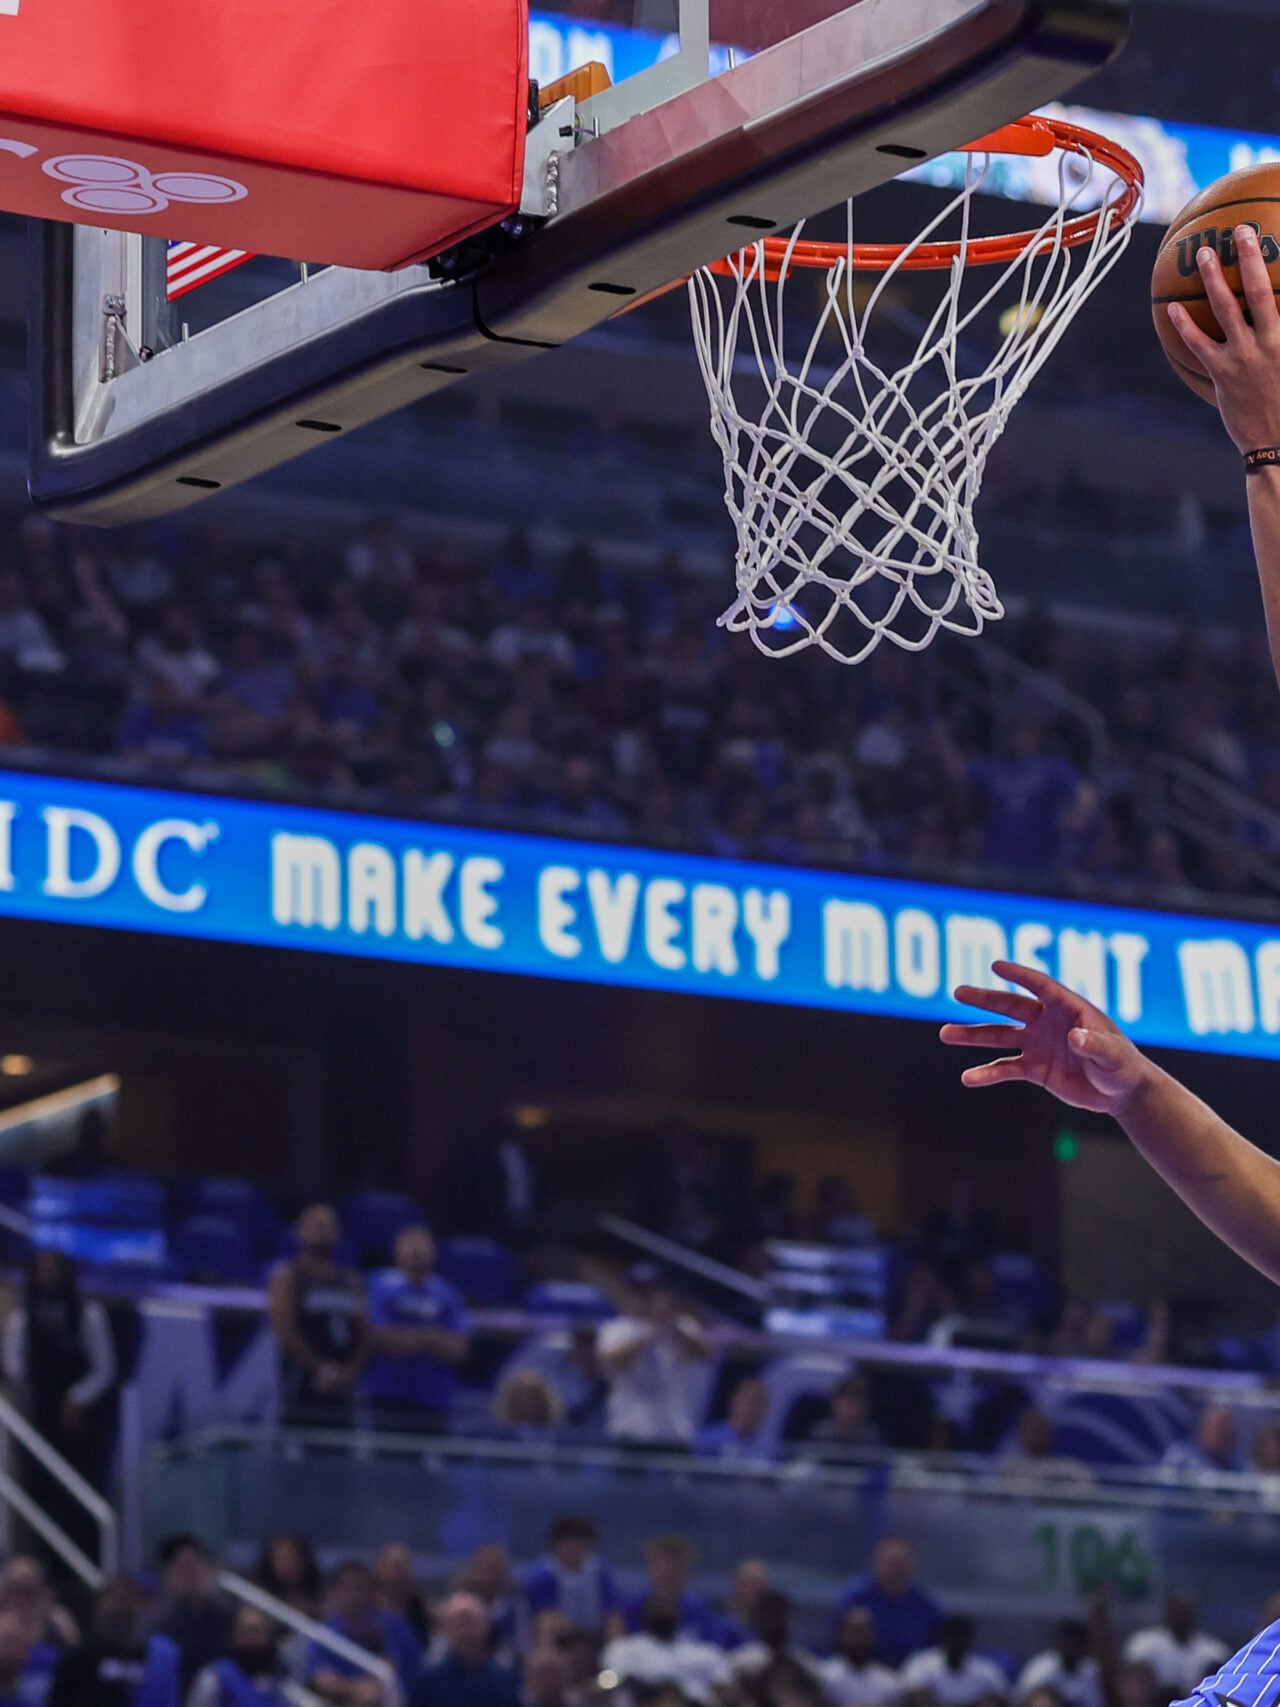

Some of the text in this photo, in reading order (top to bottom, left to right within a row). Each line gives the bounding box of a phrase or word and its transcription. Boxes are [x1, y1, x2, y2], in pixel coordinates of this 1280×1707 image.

[1256, 450, 1276, 460] Day
[0, 800, 221, 913] IDC
[272, 832, 504, 950] MAKE
[538, 866, 790, 981] EVERY
[823, 898, 1150, 1024] MOMENT
[1028, 1521, 1155, 1593] 106
